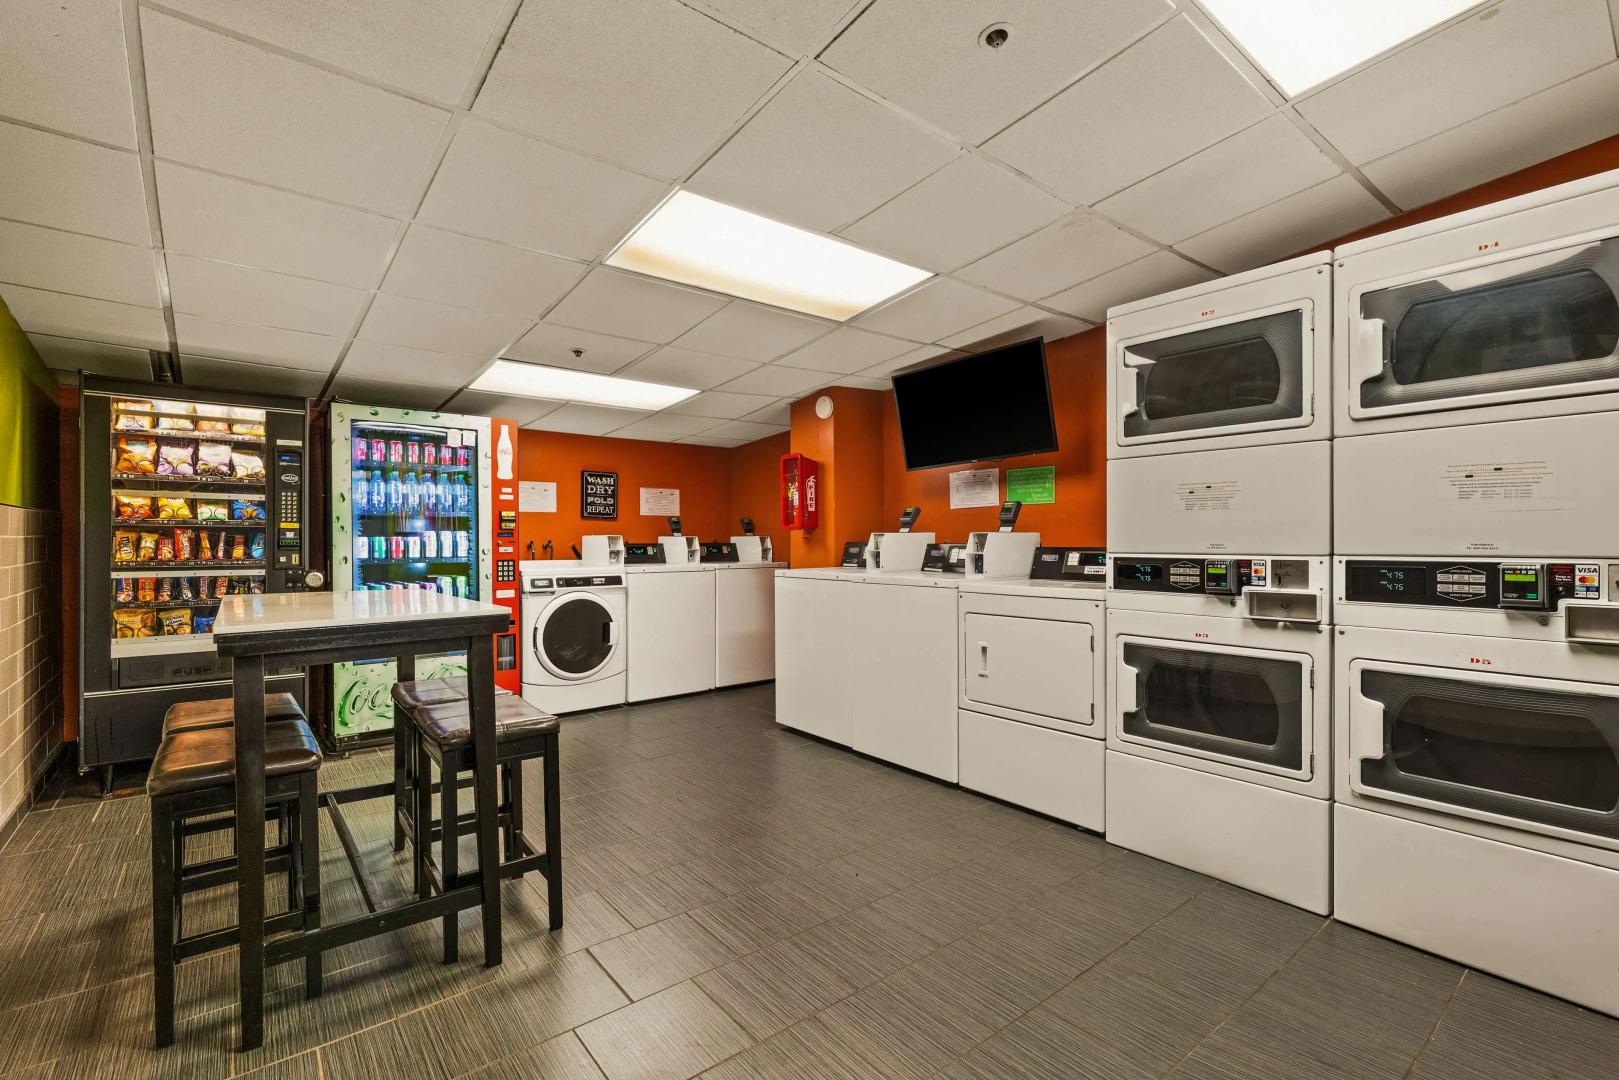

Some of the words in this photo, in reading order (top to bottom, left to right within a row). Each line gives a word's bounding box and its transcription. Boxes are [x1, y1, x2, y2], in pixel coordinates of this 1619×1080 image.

[1478, 241, 1499, 251] D4
[1201, 309, 1215, 317] D2
[587, 476, 615, 485] WASH
[586, 485, 615, 495] DRY
[587, 496, 615, 505] FOLD
[586, 505, 615, 514] REPEAT
[1469, 657, 1492, 665] D5
[172, 665, 213, 678] PUSH
